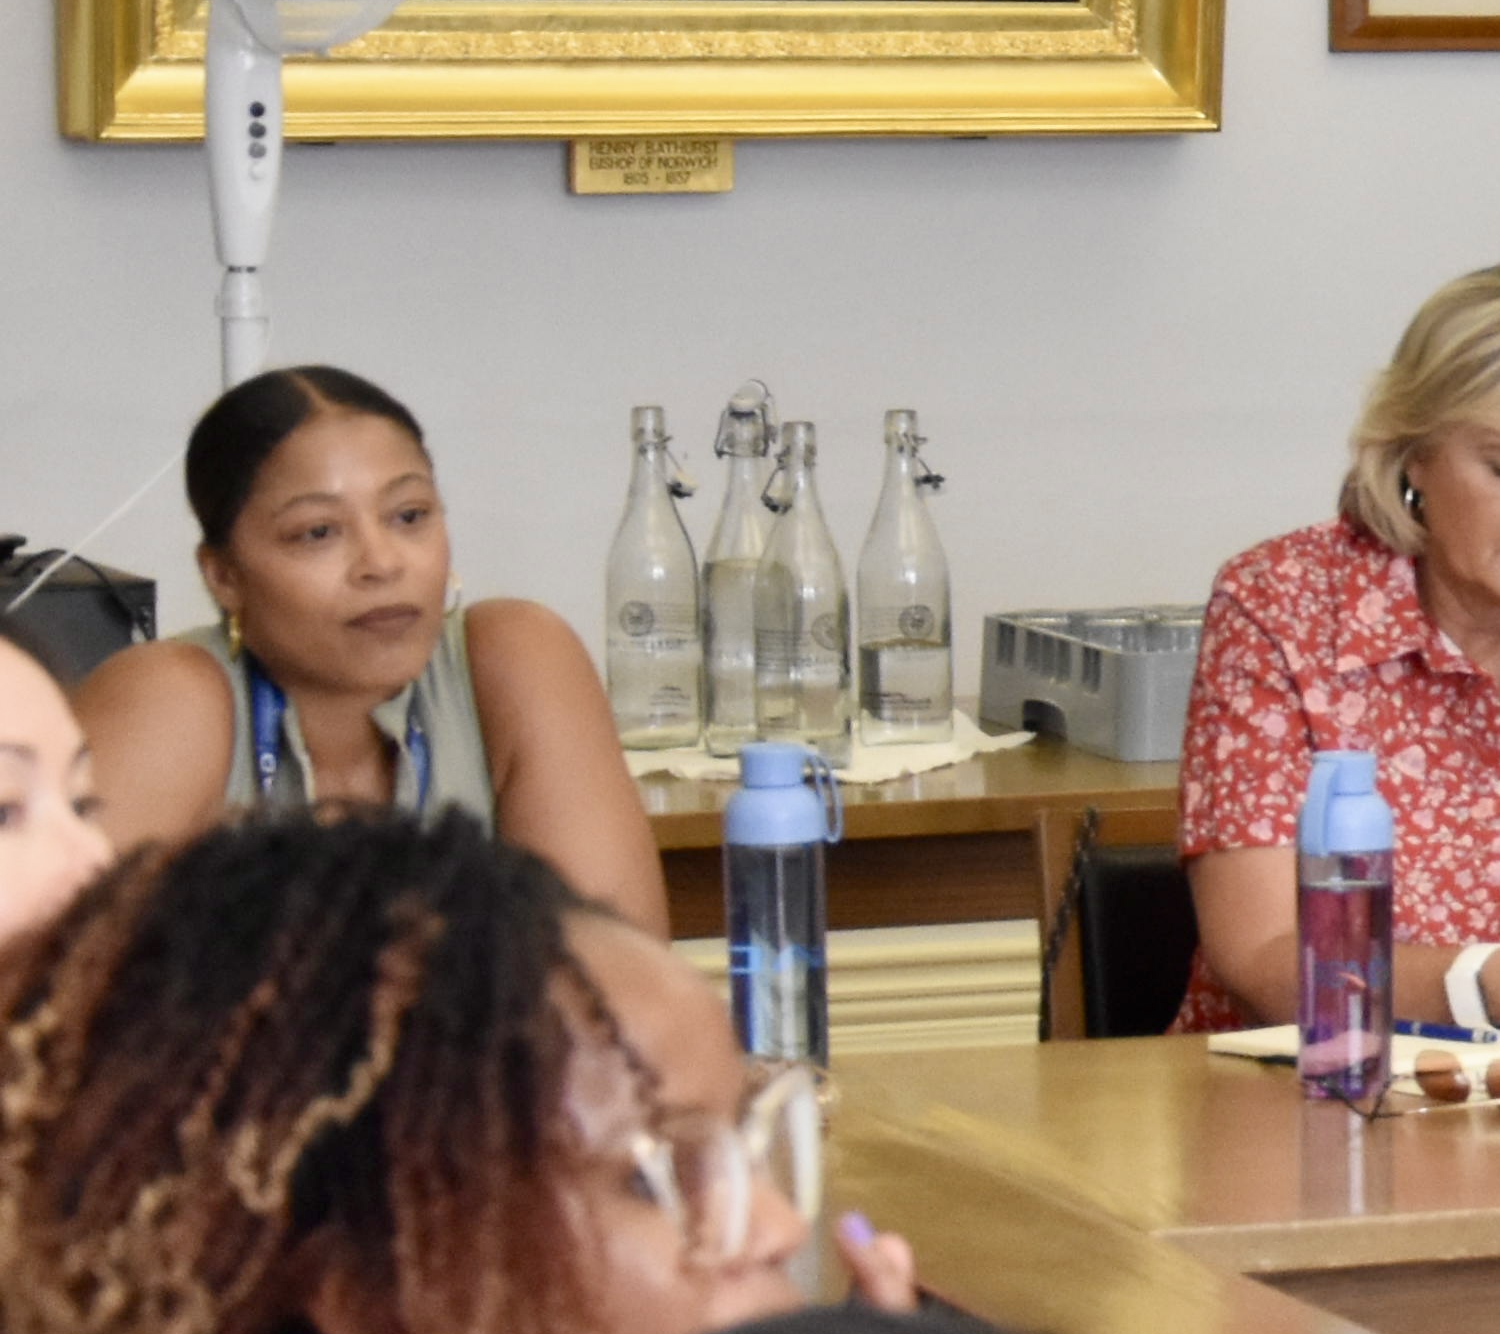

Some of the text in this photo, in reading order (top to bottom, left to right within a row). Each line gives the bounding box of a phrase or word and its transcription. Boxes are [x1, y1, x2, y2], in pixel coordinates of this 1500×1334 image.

[588, 140, 719, 155] HENRY BATHURST
[588, 155, 718, 170] BISHOP OF NORWICH
